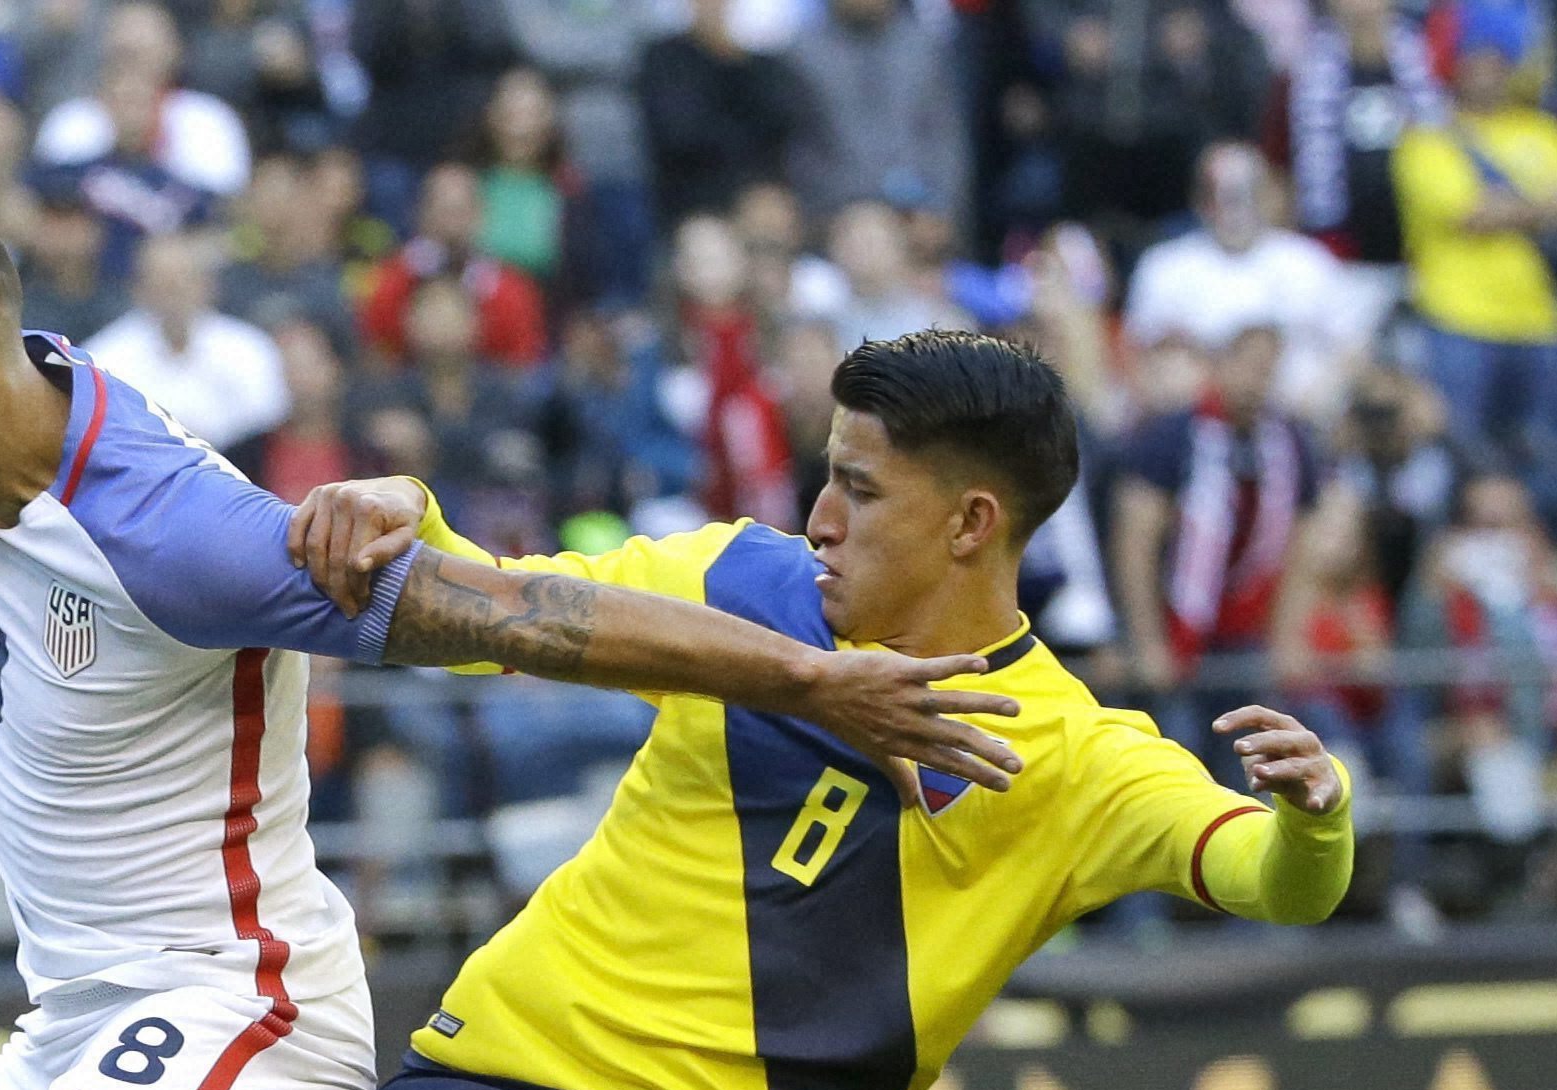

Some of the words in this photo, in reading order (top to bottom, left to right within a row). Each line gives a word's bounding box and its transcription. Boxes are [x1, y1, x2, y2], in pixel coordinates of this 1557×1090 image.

[50, 586, 92, 626] USA
[771, 766, 869, 886] 8
[98, 1017, 184, 1085] 8
